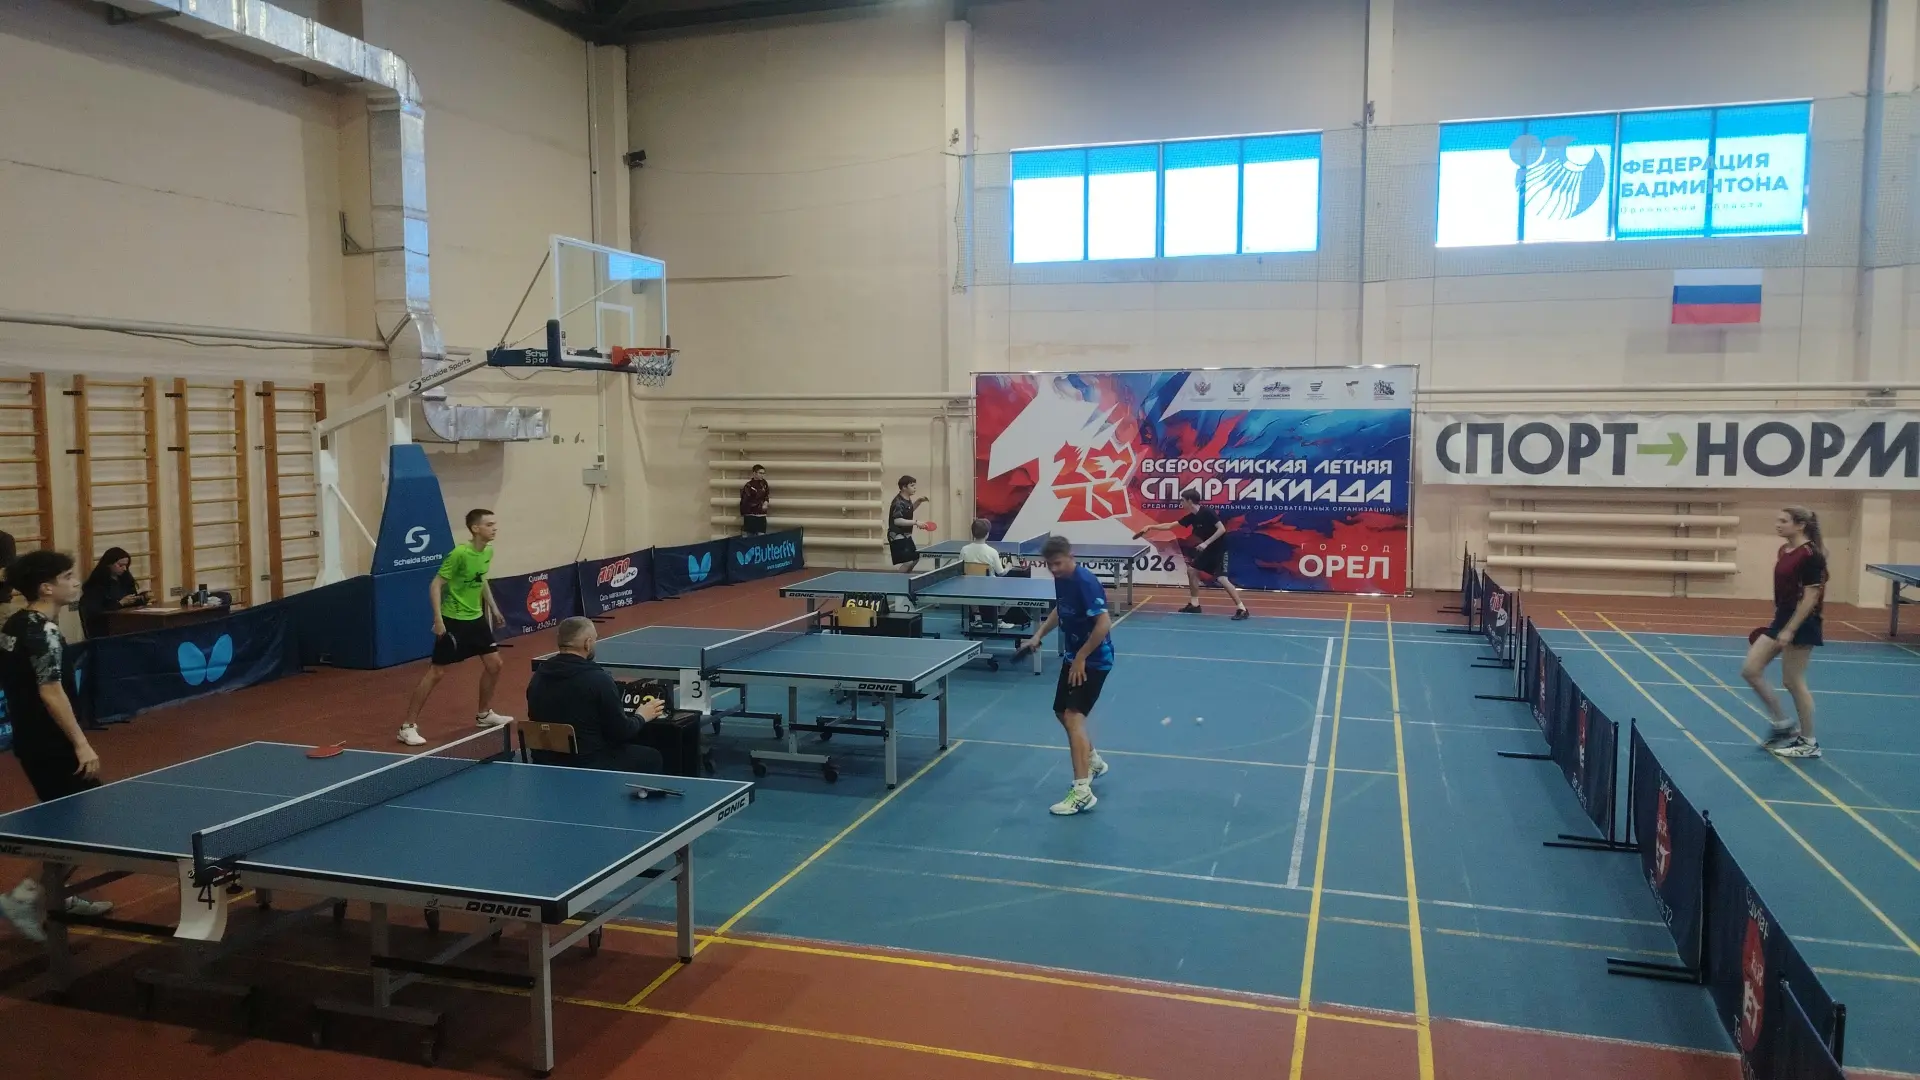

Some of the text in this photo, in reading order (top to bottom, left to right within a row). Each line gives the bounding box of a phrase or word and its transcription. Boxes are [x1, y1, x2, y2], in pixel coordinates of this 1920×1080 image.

[1622, 153, 1769, 174] ФЕДЕРАЦИЯ
[1621, 176, 1788, 198] БАДМИНТОНА
[448, 357, 471, 371] Sports
[1436, 420, 1920, 478] СПОРТ НОРМ
[1141, 458, 1392, 475] ВСЕРОССИЙСКАЯ ЛЕТНЯЯ
[1140, 477, 1391, 503] СПАРТАКИАДА
[1253, 504, 1330, 512] ОБРАЗОВАТЕЛЬНЫХ
[754, 540, 796, 564] Butterfly
[1301, 543, 1390, 553] ГОРОД
[421, 554, 443, 564] Sports
[1298, 554, 1390, 580] ОРЕЛ
[691, 681, 703, 699] 3
[857, 683, 898, 692] DONIC
[717, 797, 746, 821] DONIC
[197, 884, 216, 910] 4
[465, 900, 532, 918] DONIC
